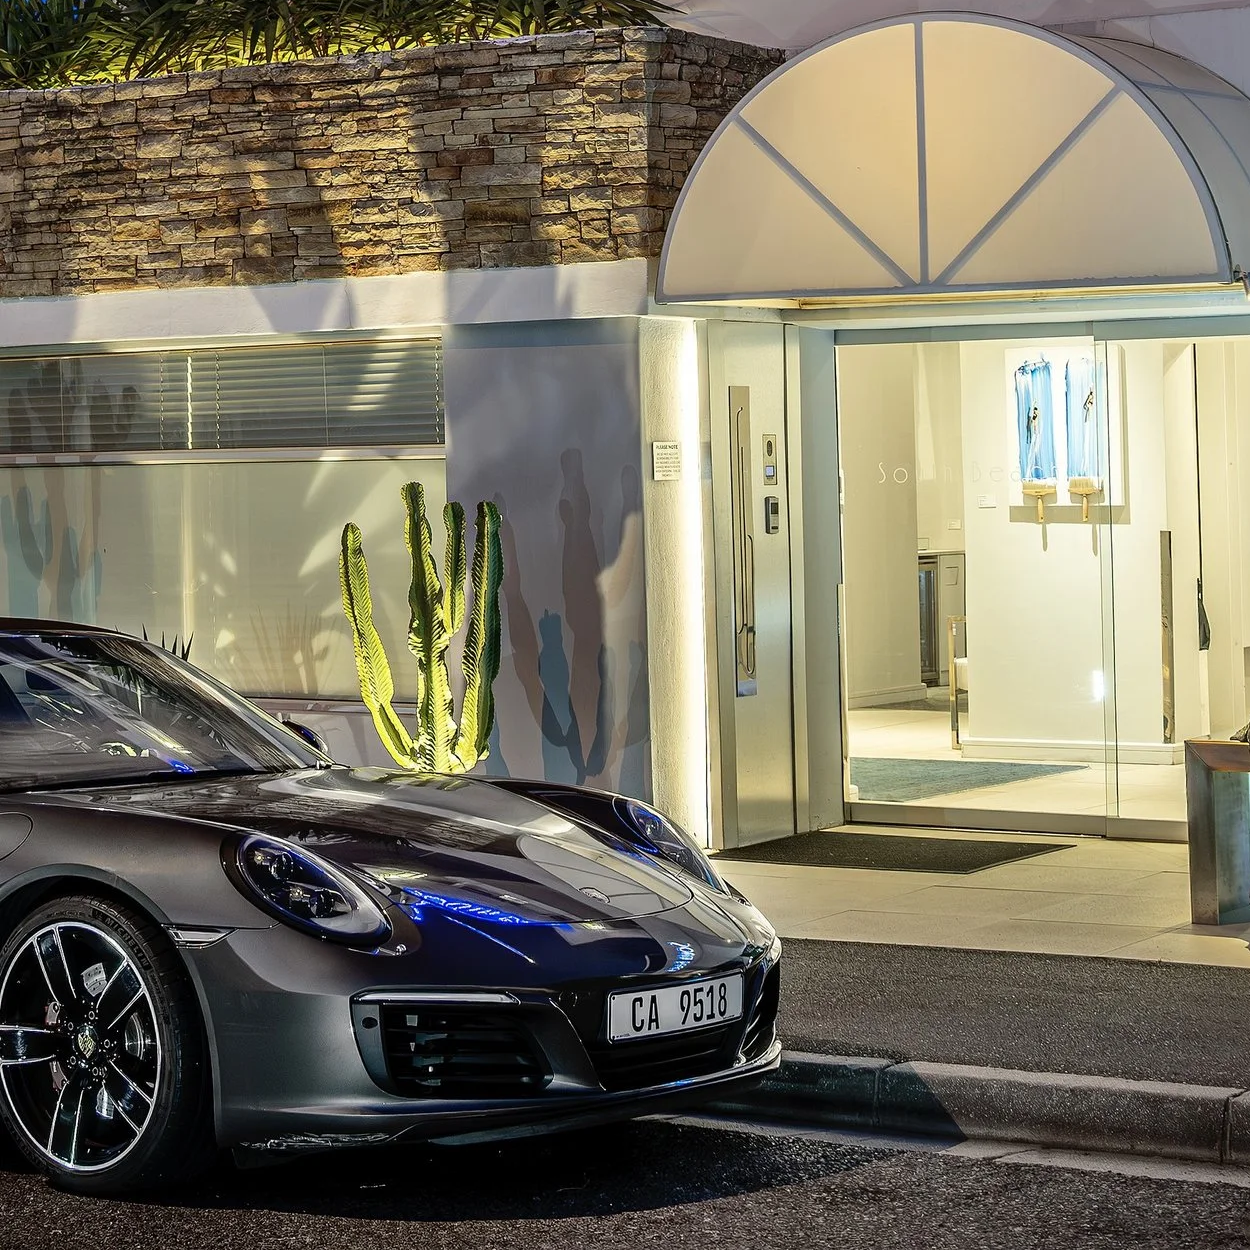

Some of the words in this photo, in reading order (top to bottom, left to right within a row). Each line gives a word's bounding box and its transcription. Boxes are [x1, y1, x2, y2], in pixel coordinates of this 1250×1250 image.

[104, 916, 151, 967] MICHELIN
[631, 994, 660, 1033] CA
[679, 982, 728, 1026] 9518
